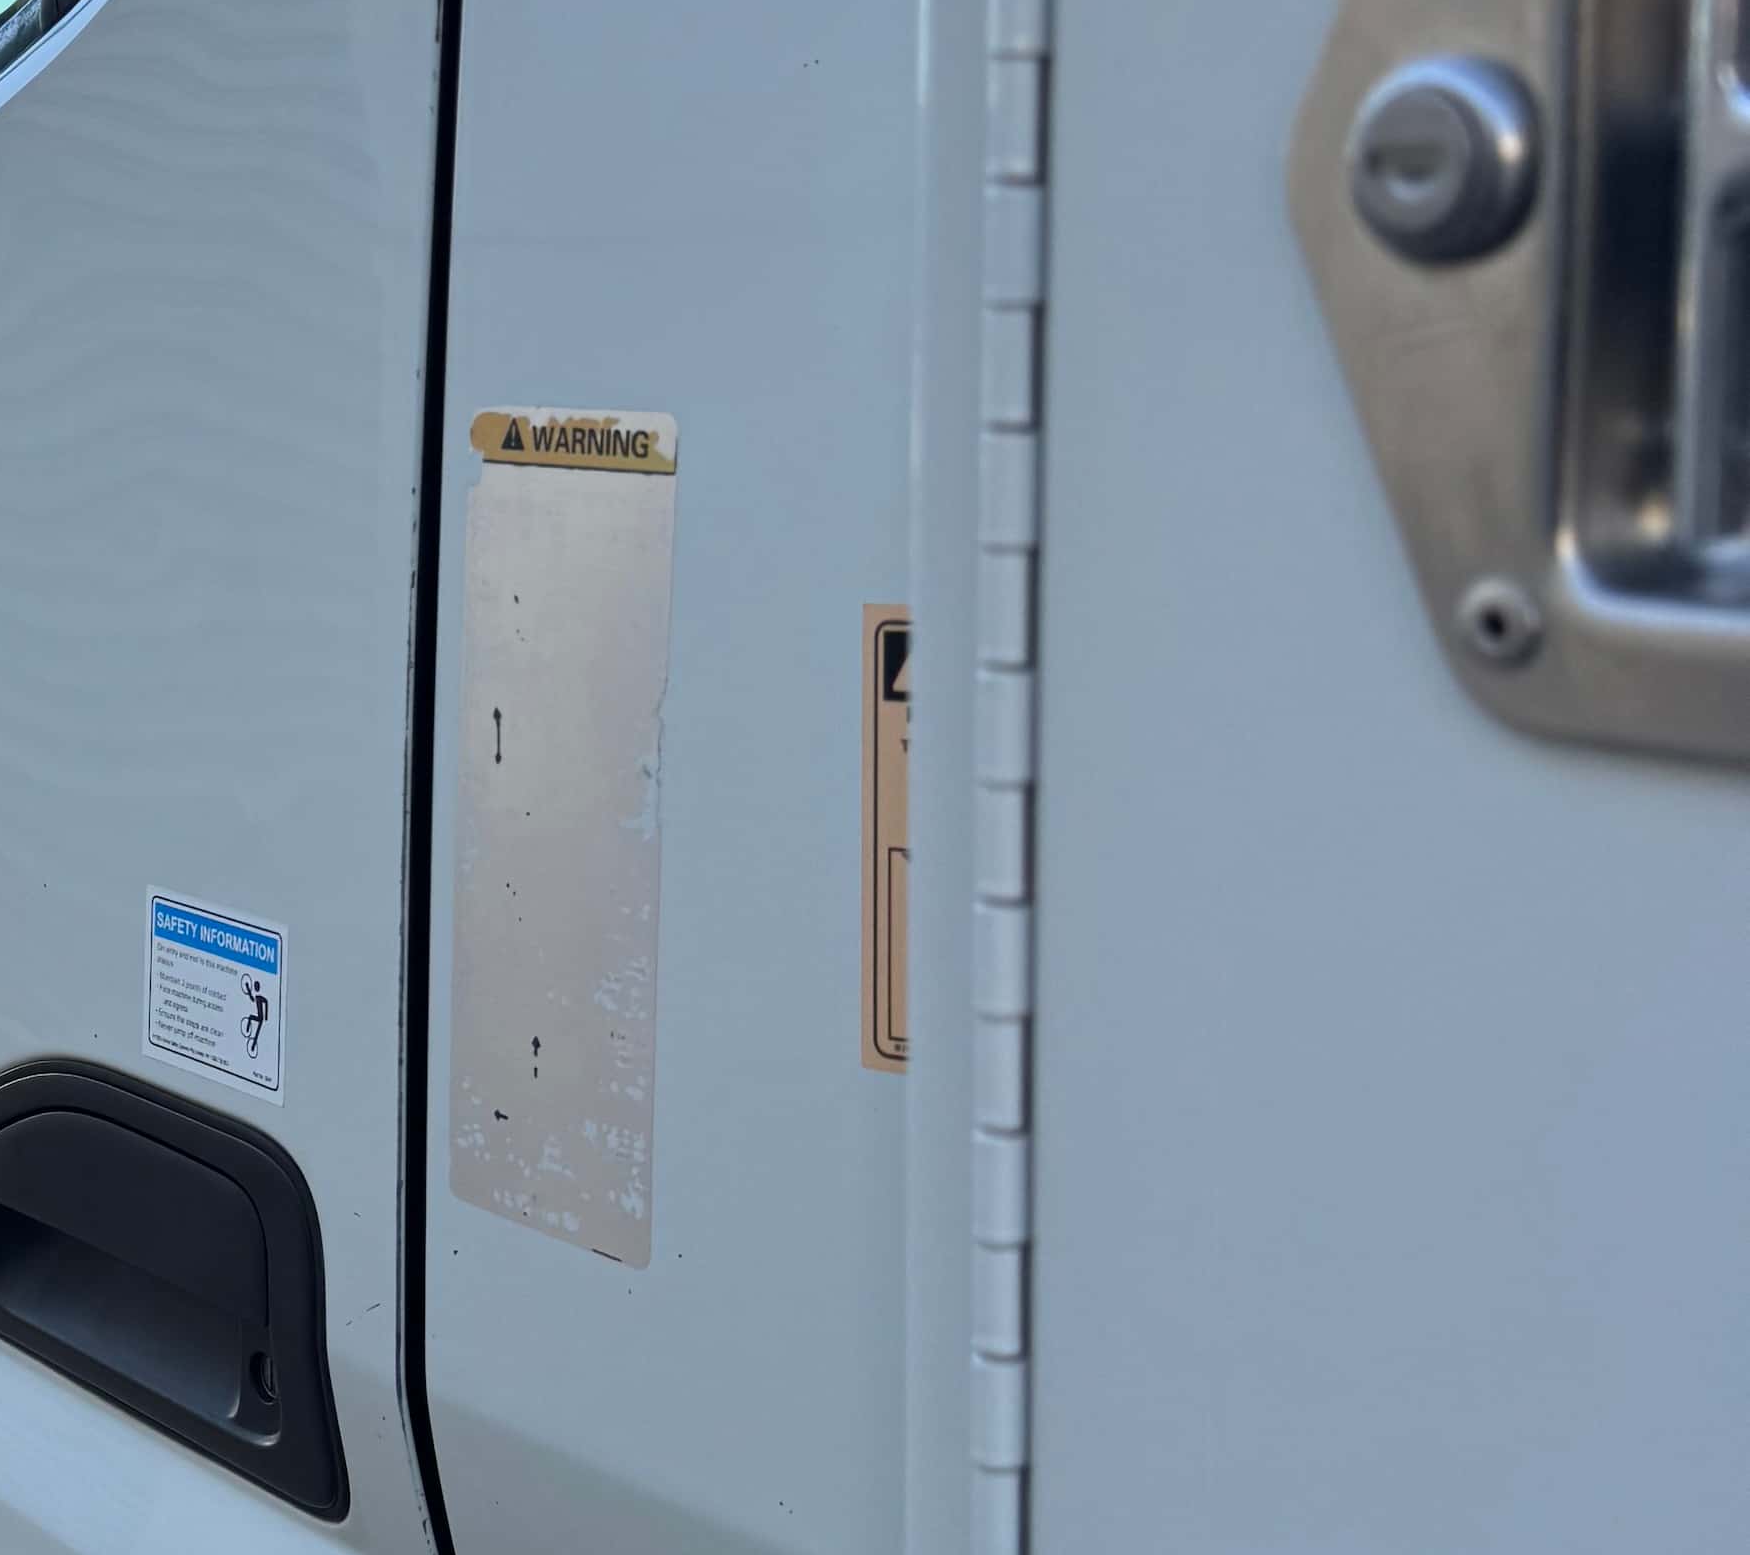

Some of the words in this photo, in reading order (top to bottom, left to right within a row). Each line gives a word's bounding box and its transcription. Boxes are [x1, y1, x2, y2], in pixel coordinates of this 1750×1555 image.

[531, 425, 649, 458] WARNING
[156, 911, 198, 938] SAFETY
[200, 925, 275, 964] INFORMATION
